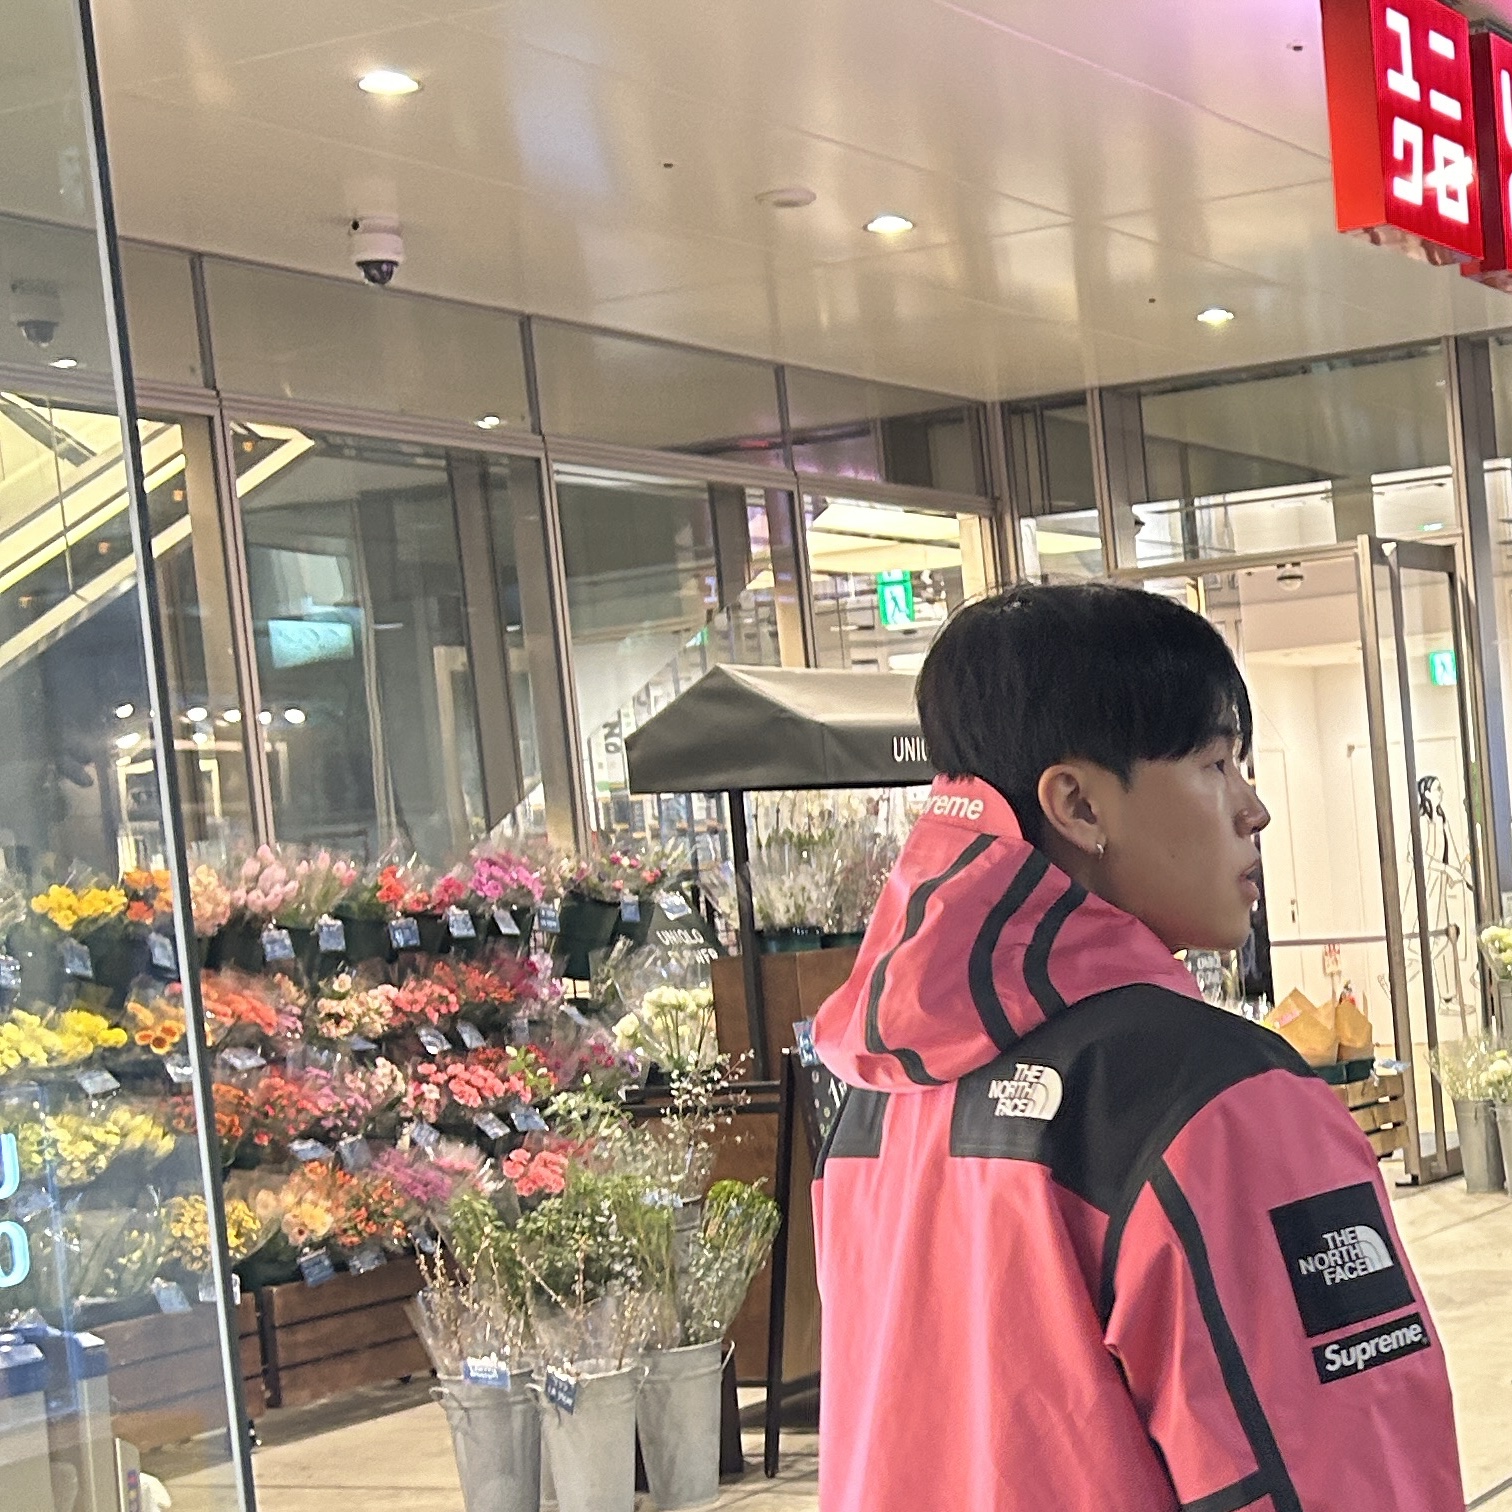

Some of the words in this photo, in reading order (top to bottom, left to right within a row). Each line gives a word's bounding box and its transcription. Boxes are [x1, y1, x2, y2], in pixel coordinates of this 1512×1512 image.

[1385, 7, 1462, 121] ユニ
[1392, 116, 1473, 225] クロ
[924, 794, 985, 820] reme
[1014, 1063, 1045, 1082] THE
[988, 1080, 1036, 1100] NORTH
[995, 1099, 1034, 1117] FACE
[1322, 1226, 1358, 1251] THE
[1298, 1242, 1363, 1275] NORTH
[1322, 1258, 1370, 1286] FACE
[1325, 1322, 1424, 1372] Supreme
